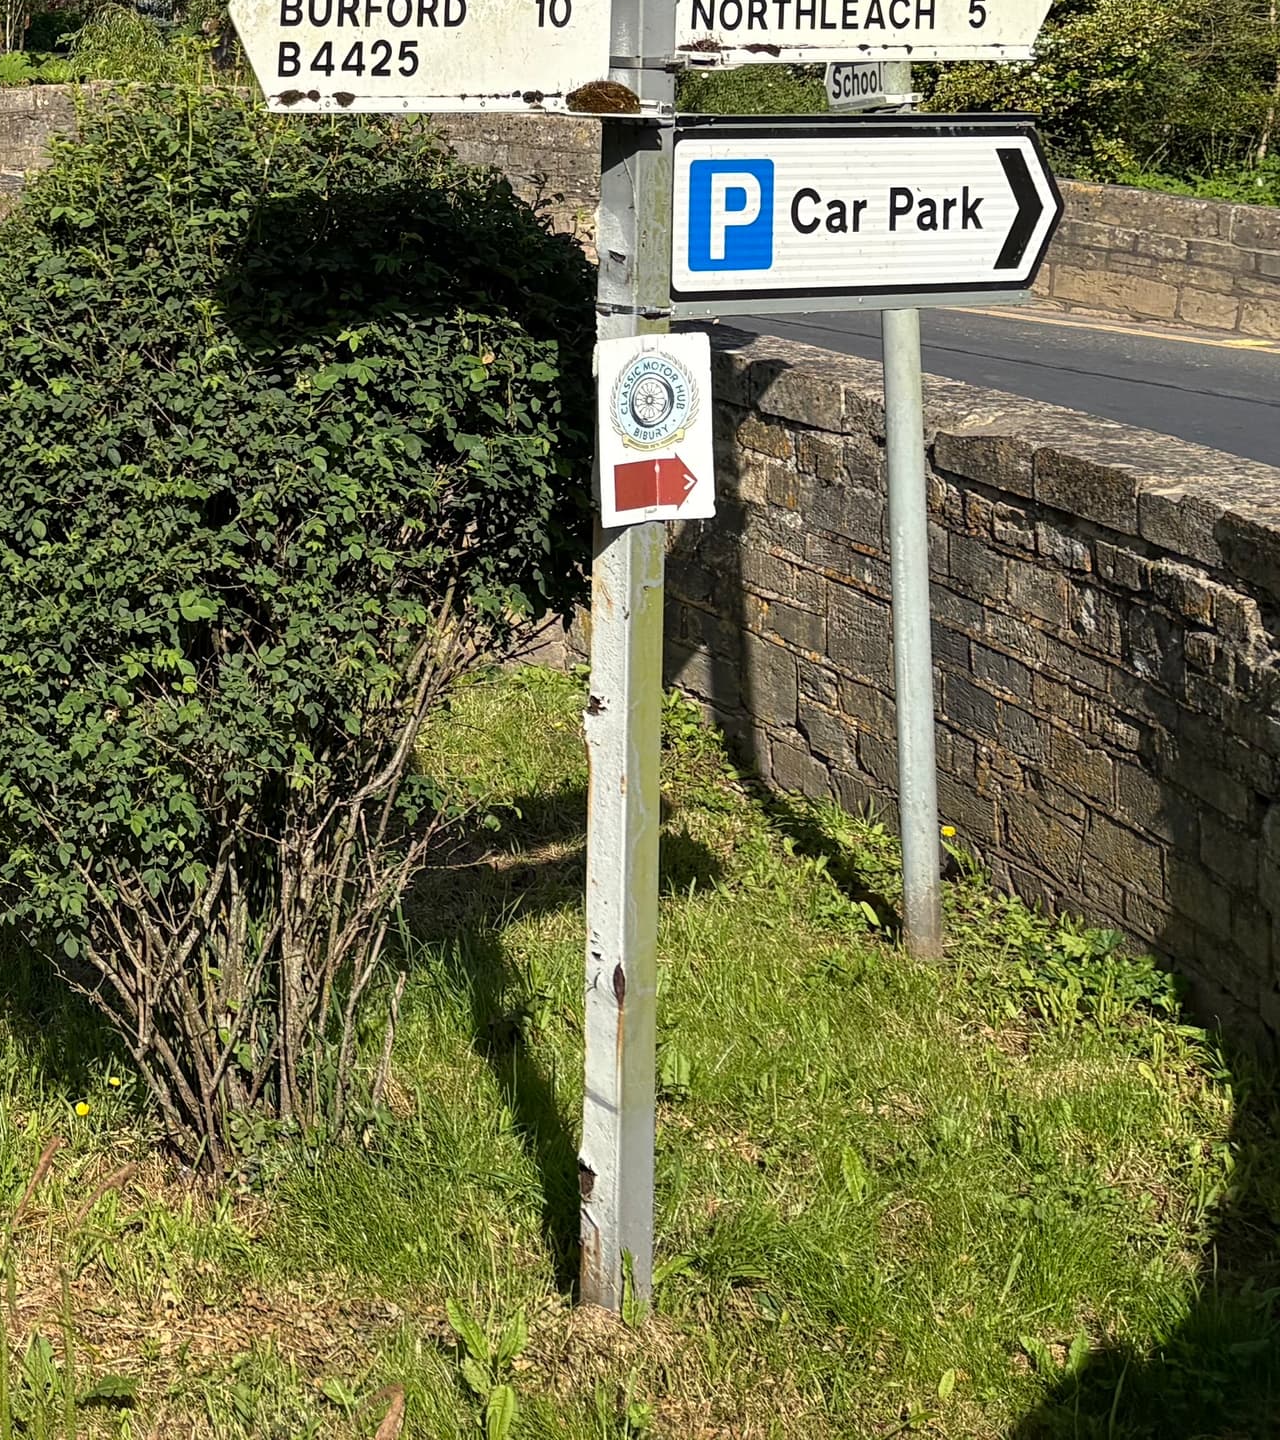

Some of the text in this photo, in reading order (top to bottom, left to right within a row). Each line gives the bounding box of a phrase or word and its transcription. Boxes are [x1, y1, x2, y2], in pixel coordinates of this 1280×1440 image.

[832, 62, 883, 99] School
[710, 172, 984, 260] P Car Park
[620, 361, 686, 415] CLASSIC MOTOR HUB
[633, 424, 669, 441] BIBURY
